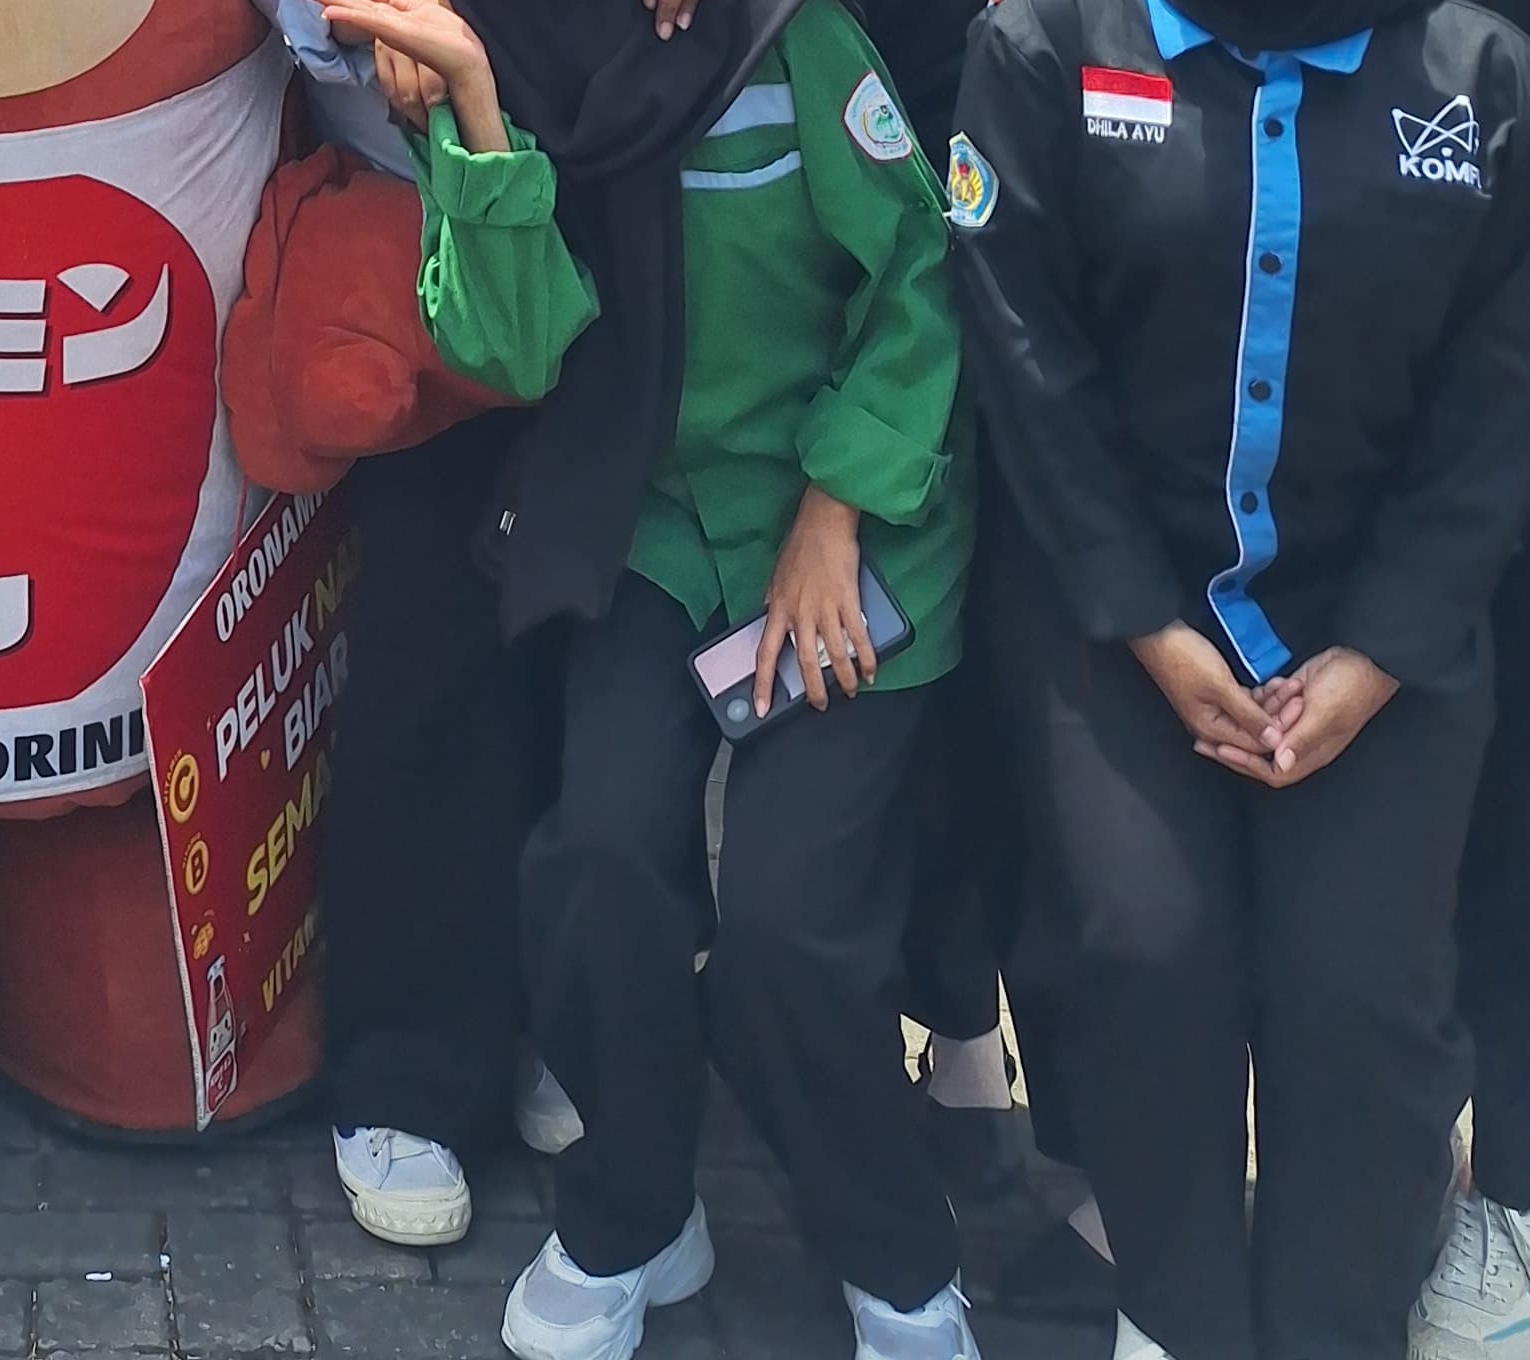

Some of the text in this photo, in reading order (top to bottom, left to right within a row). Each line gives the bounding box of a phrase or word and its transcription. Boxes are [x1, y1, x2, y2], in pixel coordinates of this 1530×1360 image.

[1087, 117, 1165, 144] DHILA AYU
[214, 593, 315, 783] PELUK
[283, 631, 350, 772] BIAR
[245, 750, 330, 917] SEMA
